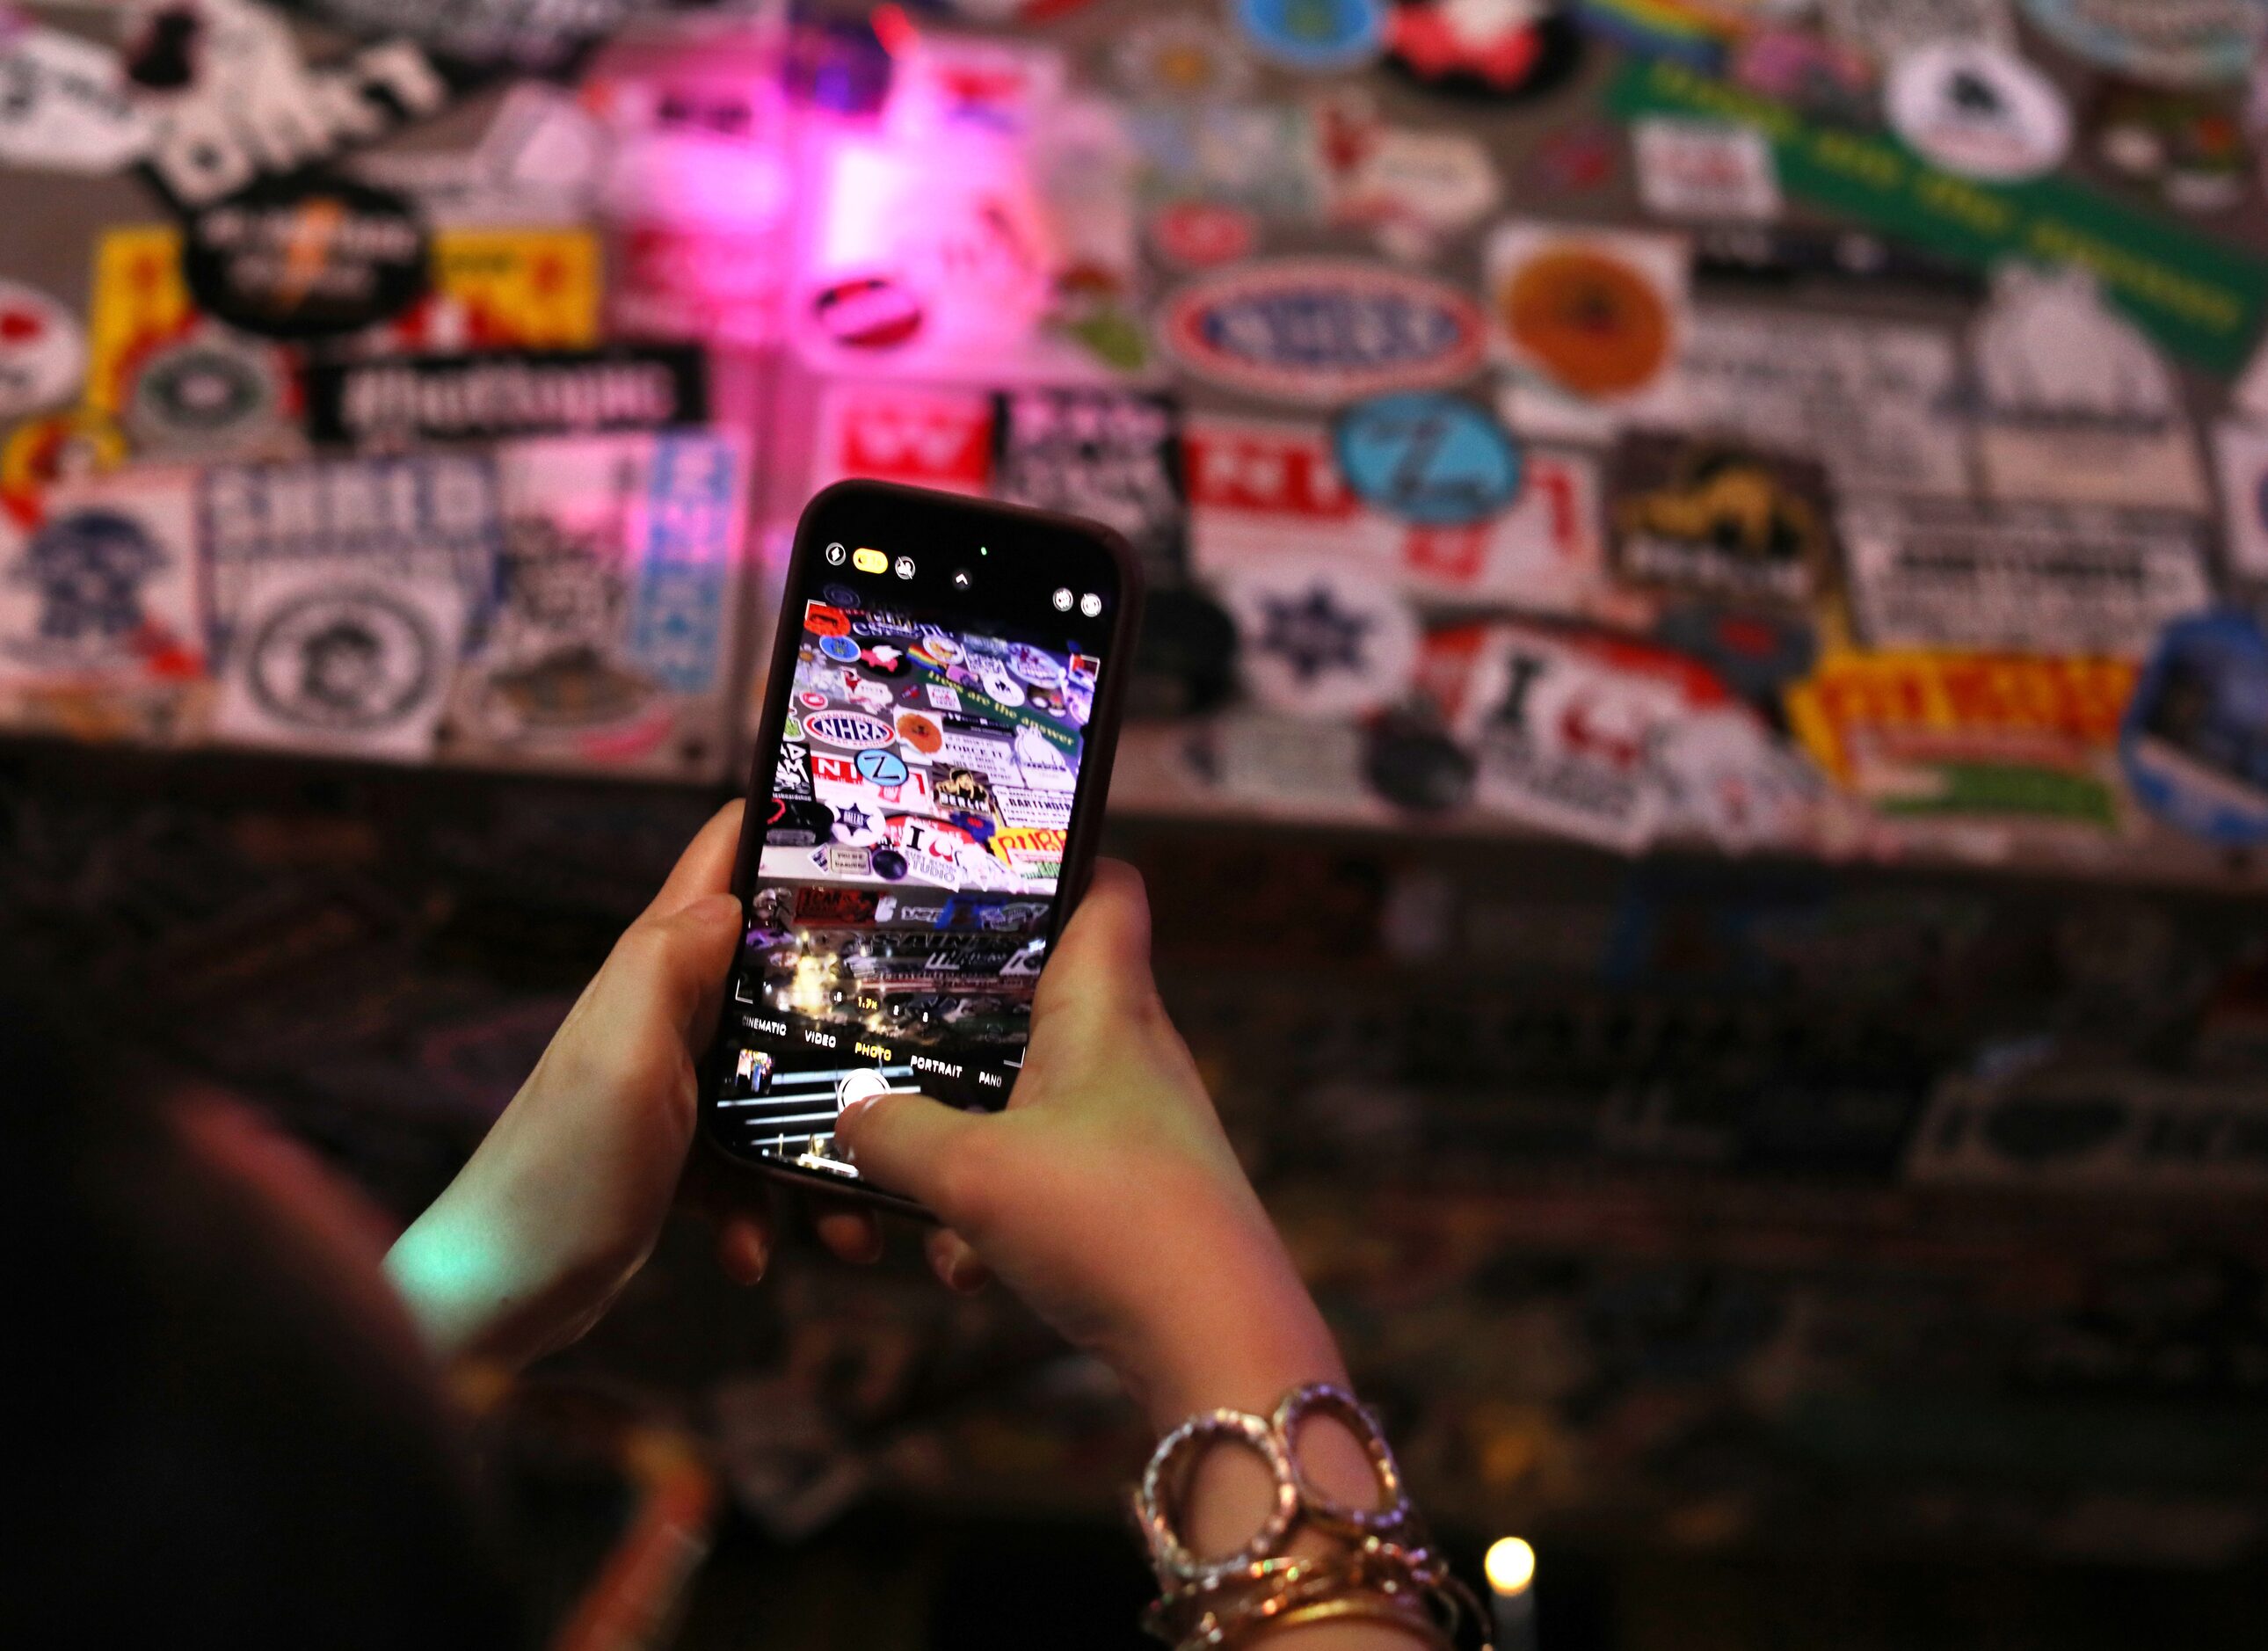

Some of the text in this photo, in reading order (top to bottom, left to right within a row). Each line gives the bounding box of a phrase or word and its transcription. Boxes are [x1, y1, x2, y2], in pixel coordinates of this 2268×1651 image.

[927, 670, 963, 695] trees
[967, 690, 991, 707] are
[994, 702, 1018, 720] the
[1021, 716, 1074, 747] answer
[819, 718, 885, 741] NHRA
[945, 743, 986, 756] FORCE
[863, 756, 901, 781] Z
[941, 792, 990, 814] BERLIN
[1008, 798, 1072, 811] BARTENDER
[843, 810, 865, 826] DALLAS
[906, 825, 926, 852] I
[742, 1015, 1003, 1089] CINEMATIC VIDEO PHOTO PORTRAIT PANO
